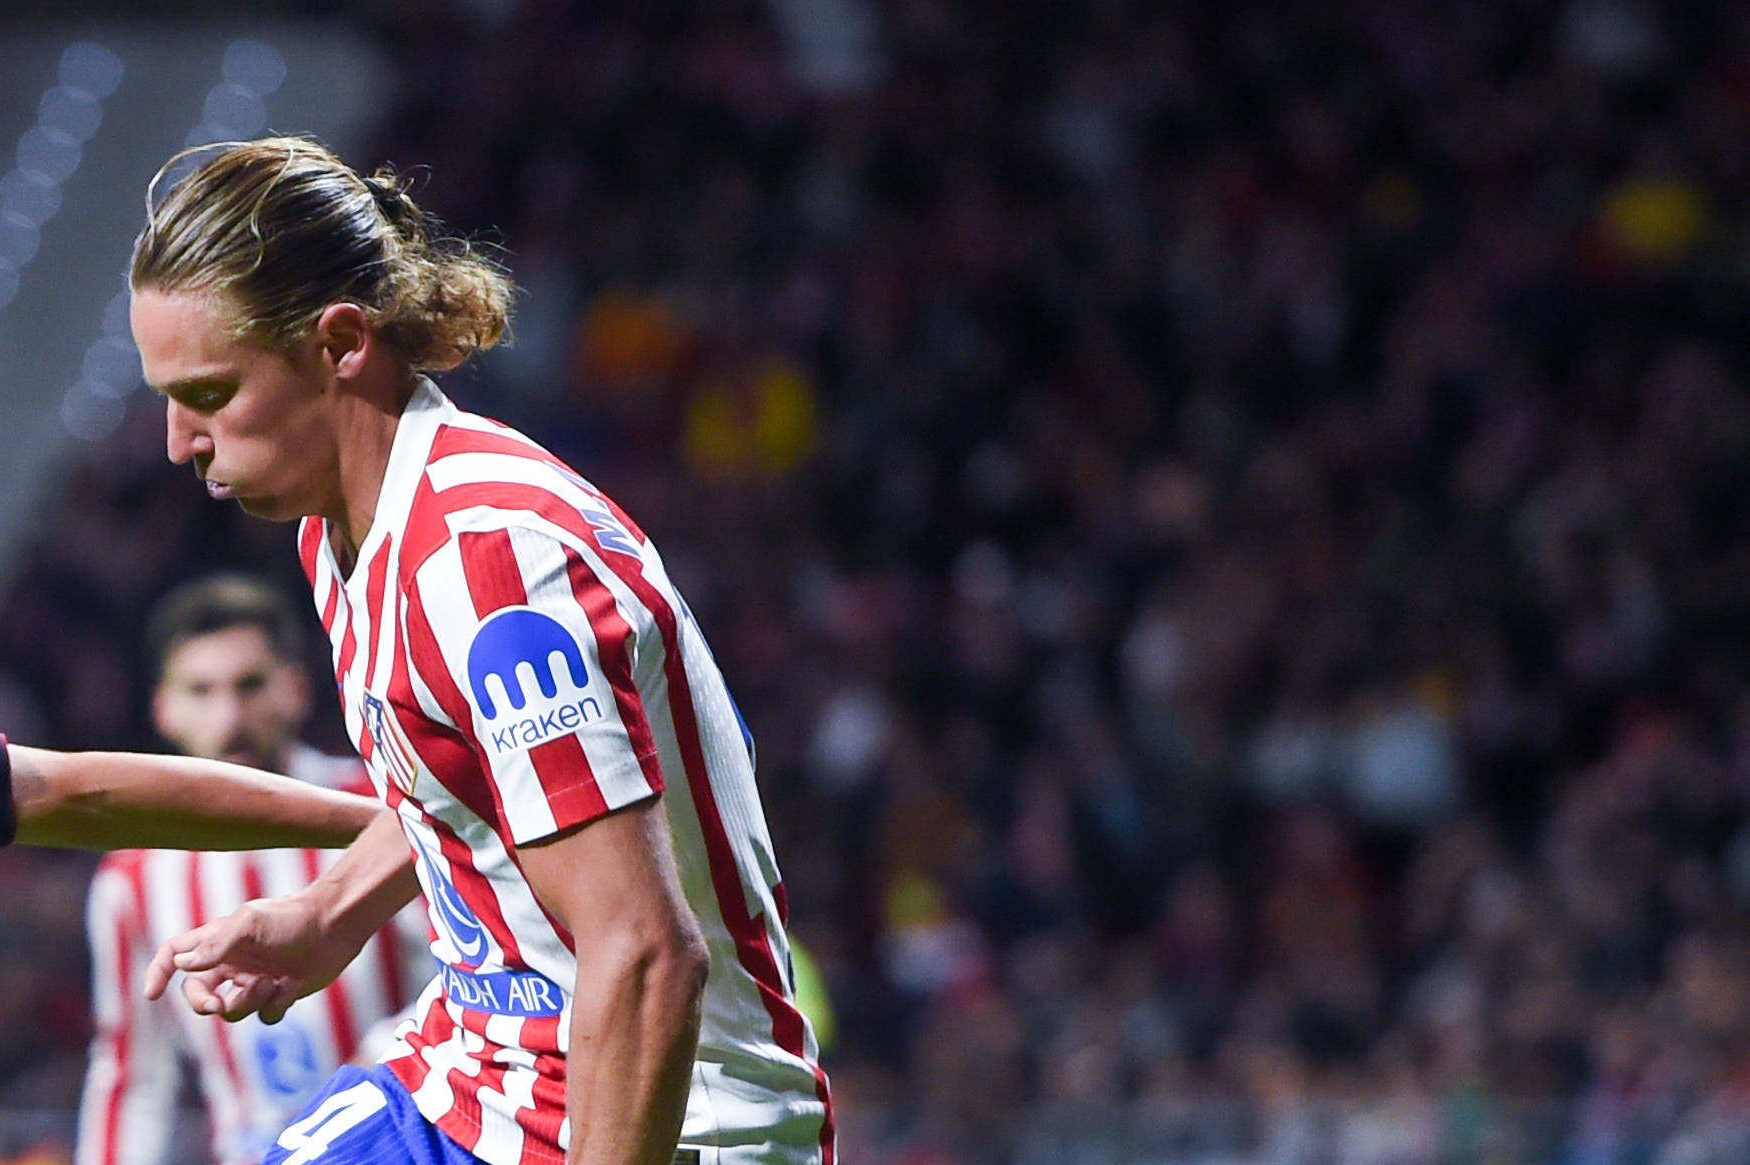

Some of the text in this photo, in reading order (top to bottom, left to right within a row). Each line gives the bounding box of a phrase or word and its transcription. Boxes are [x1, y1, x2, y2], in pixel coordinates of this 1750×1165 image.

[491, 697, 602, 754] kraken
[442, 964, 558, 1012] ADH AIR
